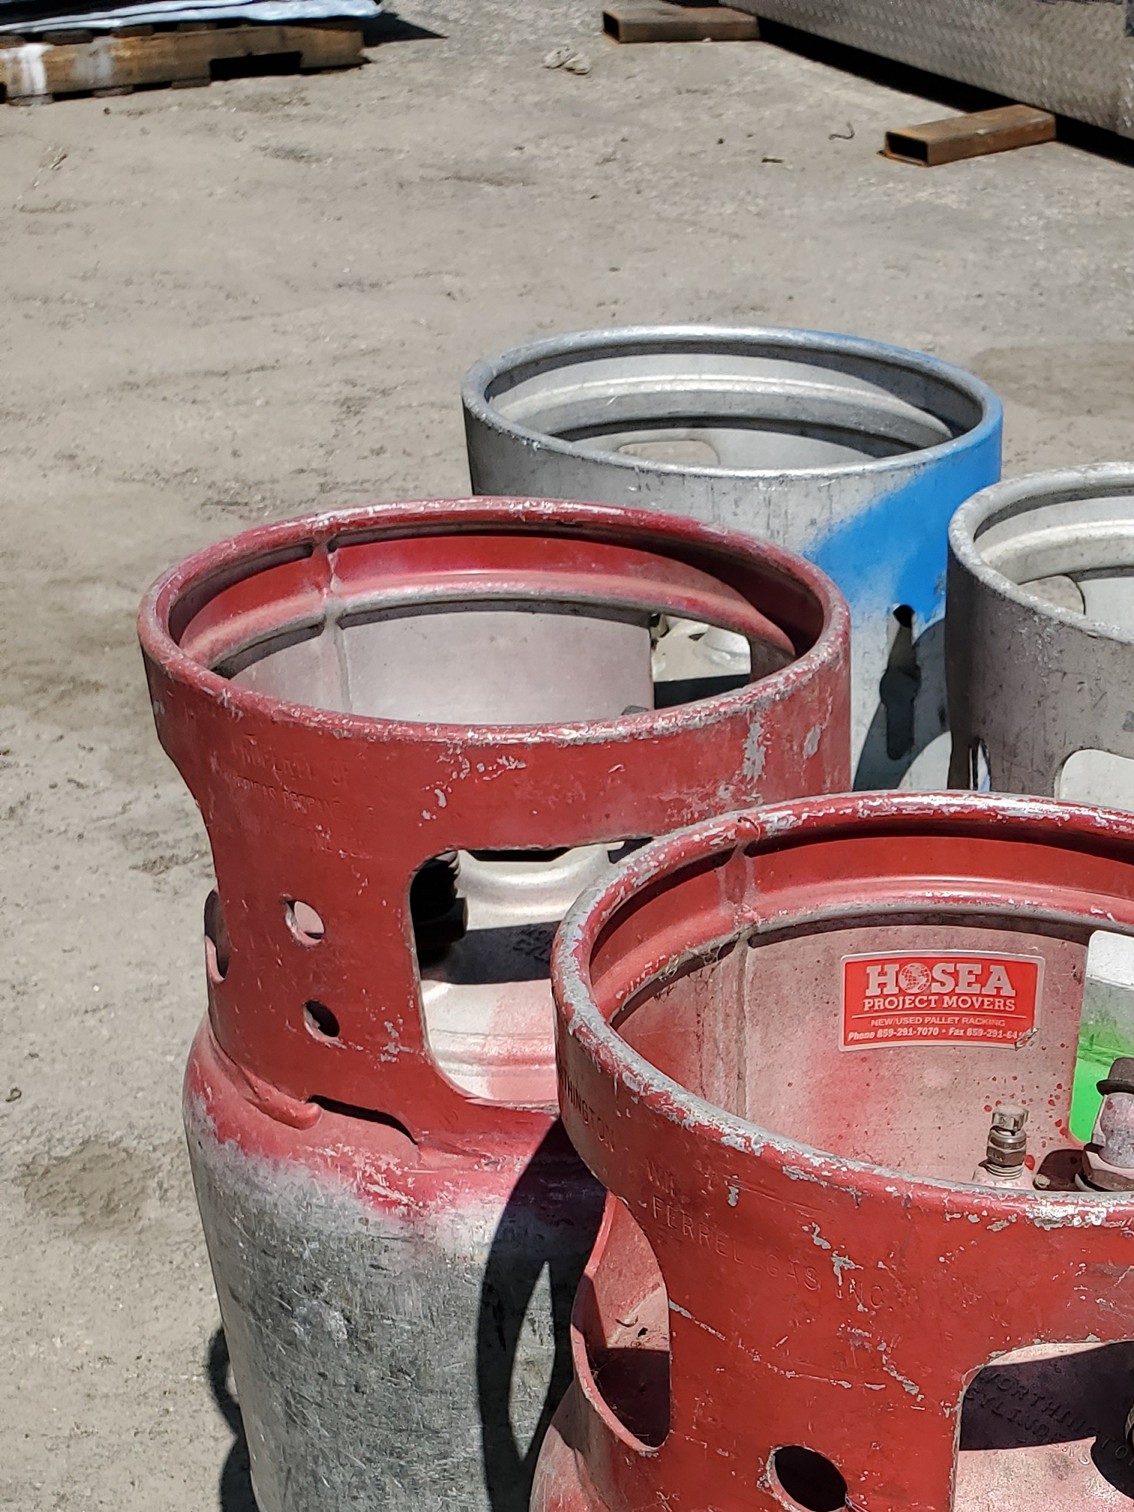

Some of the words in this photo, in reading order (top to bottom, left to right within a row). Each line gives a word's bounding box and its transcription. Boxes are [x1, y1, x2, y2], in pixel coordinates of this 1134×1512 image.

[866, 962, 1016, 997] HOSEA
[863, 995, 939, 1012] PROJECT
[942, 996, 1016, 1012] MOVERS
[871, 1016, 922, 1027] NEW/USED
[924, 1016, 959, 1025] PALLET
[961, 1017, 1006, 1027] RACKING
[848, 1031, 875, 1041] Phone
[948, 1027, 964, 1036] Fax
[966, 1028, 1023, 1039] 859-291-64
